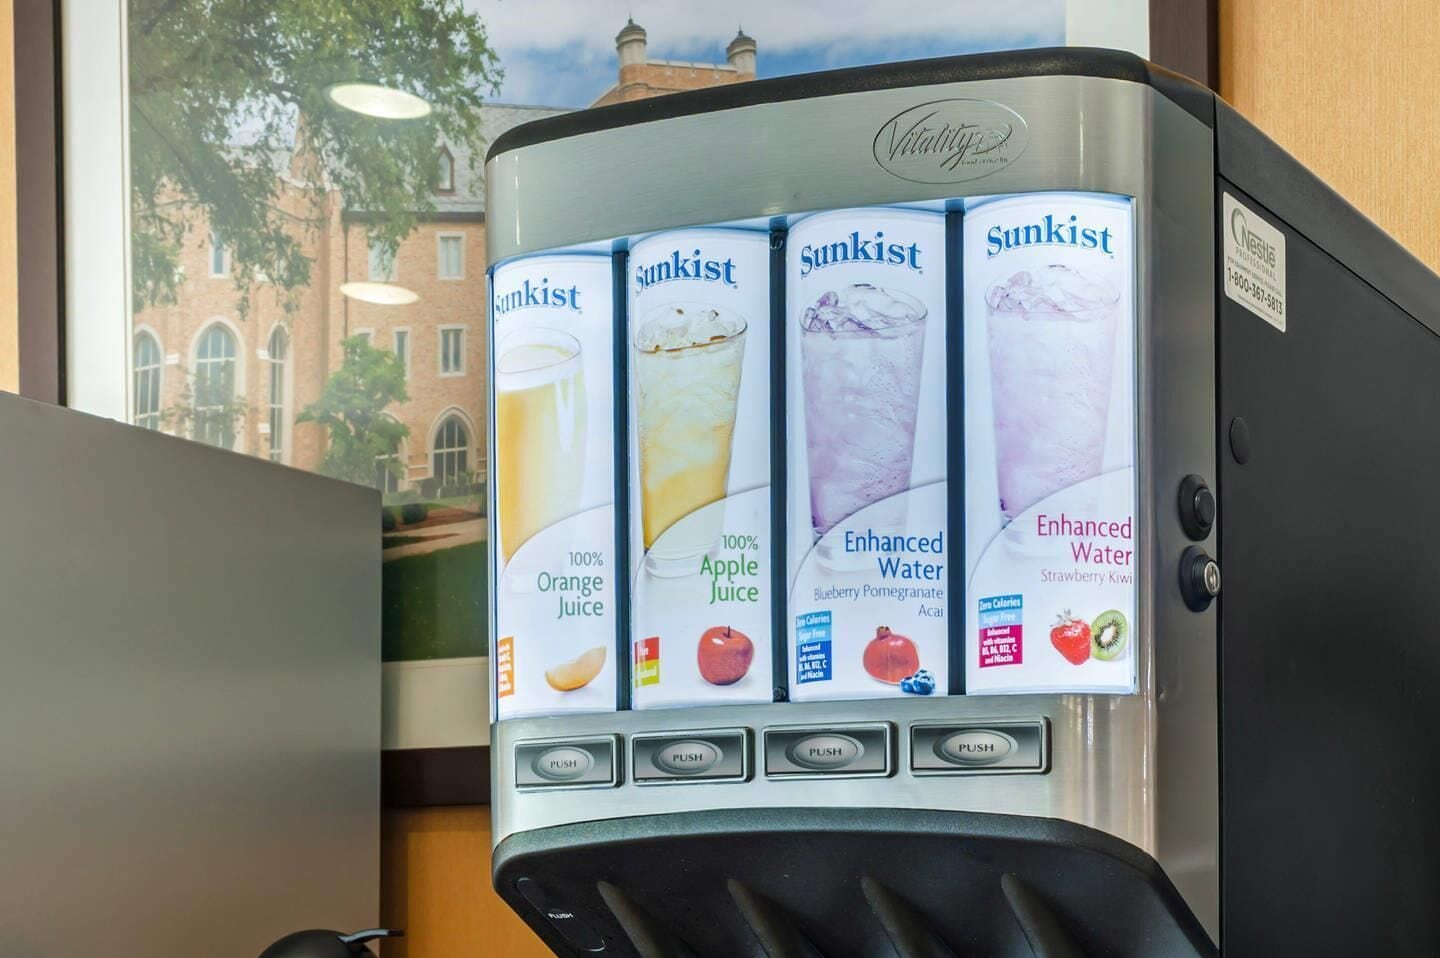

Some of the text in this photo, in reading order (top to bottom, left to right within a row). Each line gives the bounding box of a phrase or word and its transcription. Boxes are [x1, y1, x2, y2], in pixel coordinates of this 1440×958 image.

[889, 111, 980, 171] Vitality
[987, 214, 1112, 257] Sunkist
[800, 231, 922, 277] Sunkist
[635, 249, 737, 293] Sunkist
[1038, 513, 1132, 539] Enhanced
[722, 535, 758, 550] 100%
[845, 529, 943, 553] Enhanced
[569, 552, 604, 566] 100%
[1071, 542, 1132, 565] Water
[700, 553, 758, 581] Apple
[878, 557, 943, 580] Water
[537, 572, 603, 597] Orange
[1041, 569, 1132, 586] Strawberry Kiwi
[710, 580, 759, 604] Juice
[814, 584, 943, 601] Blueberry Pomegranate
[558, 596, 604, 619] Juice
[918, 604, 943, 617] Acai
[993, 597, 1021, 608] Calories
[806, 615, 830, 625] Calories
[1012, 644, 1018, 653] C
[673, 753, 703, 763] PUSH
[809, 747, 842, 757] PUSH
[959, 743, 994, 753] PUSH
[550, 759, 577, 769] PUSH
